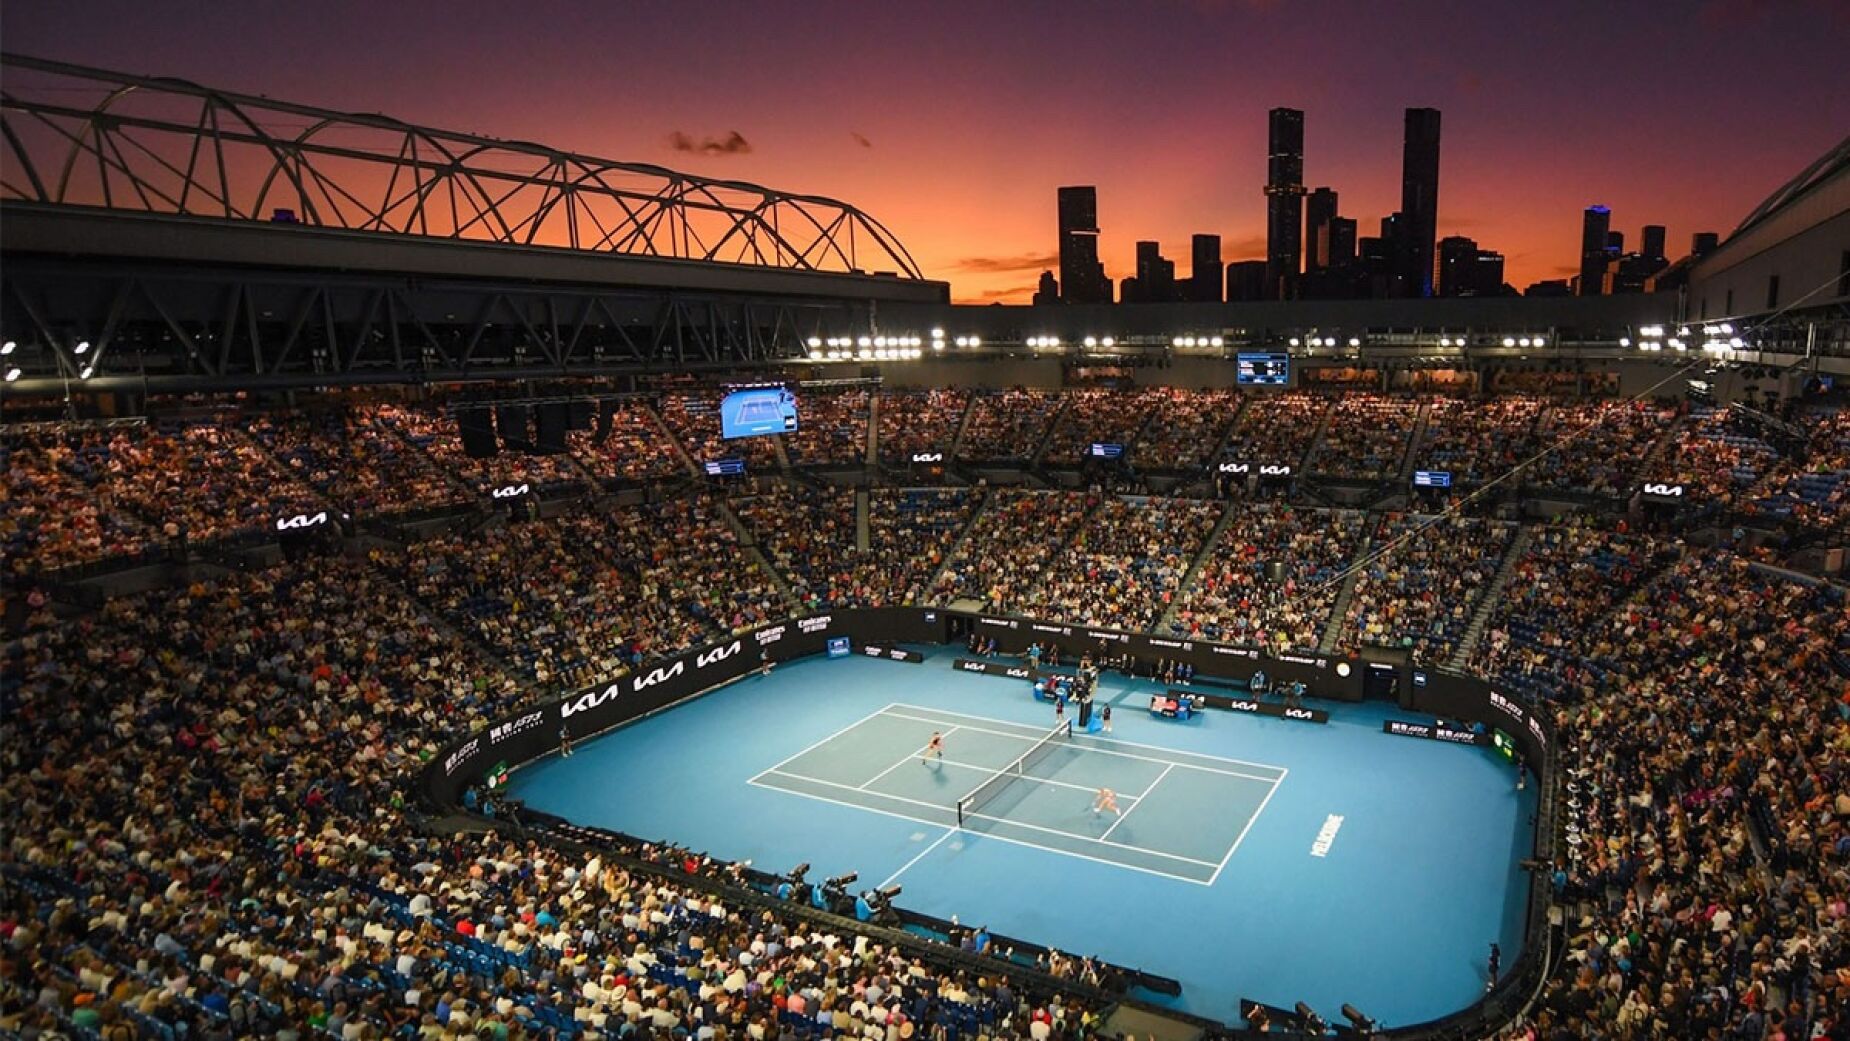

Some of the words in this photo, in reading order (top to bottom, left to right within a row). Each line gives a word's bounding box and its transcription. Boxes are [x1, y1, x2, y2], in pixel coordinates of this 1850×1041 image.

[276, 512, 327, 530] KIA
[696, 640, 741, 668] KIA
[633, 661, 684, 692] KIA
[561, 684, 618, 718] KIA
[1231, 701, 1258, 711] KIA
[1285, 708, 1313, 719] KIA
